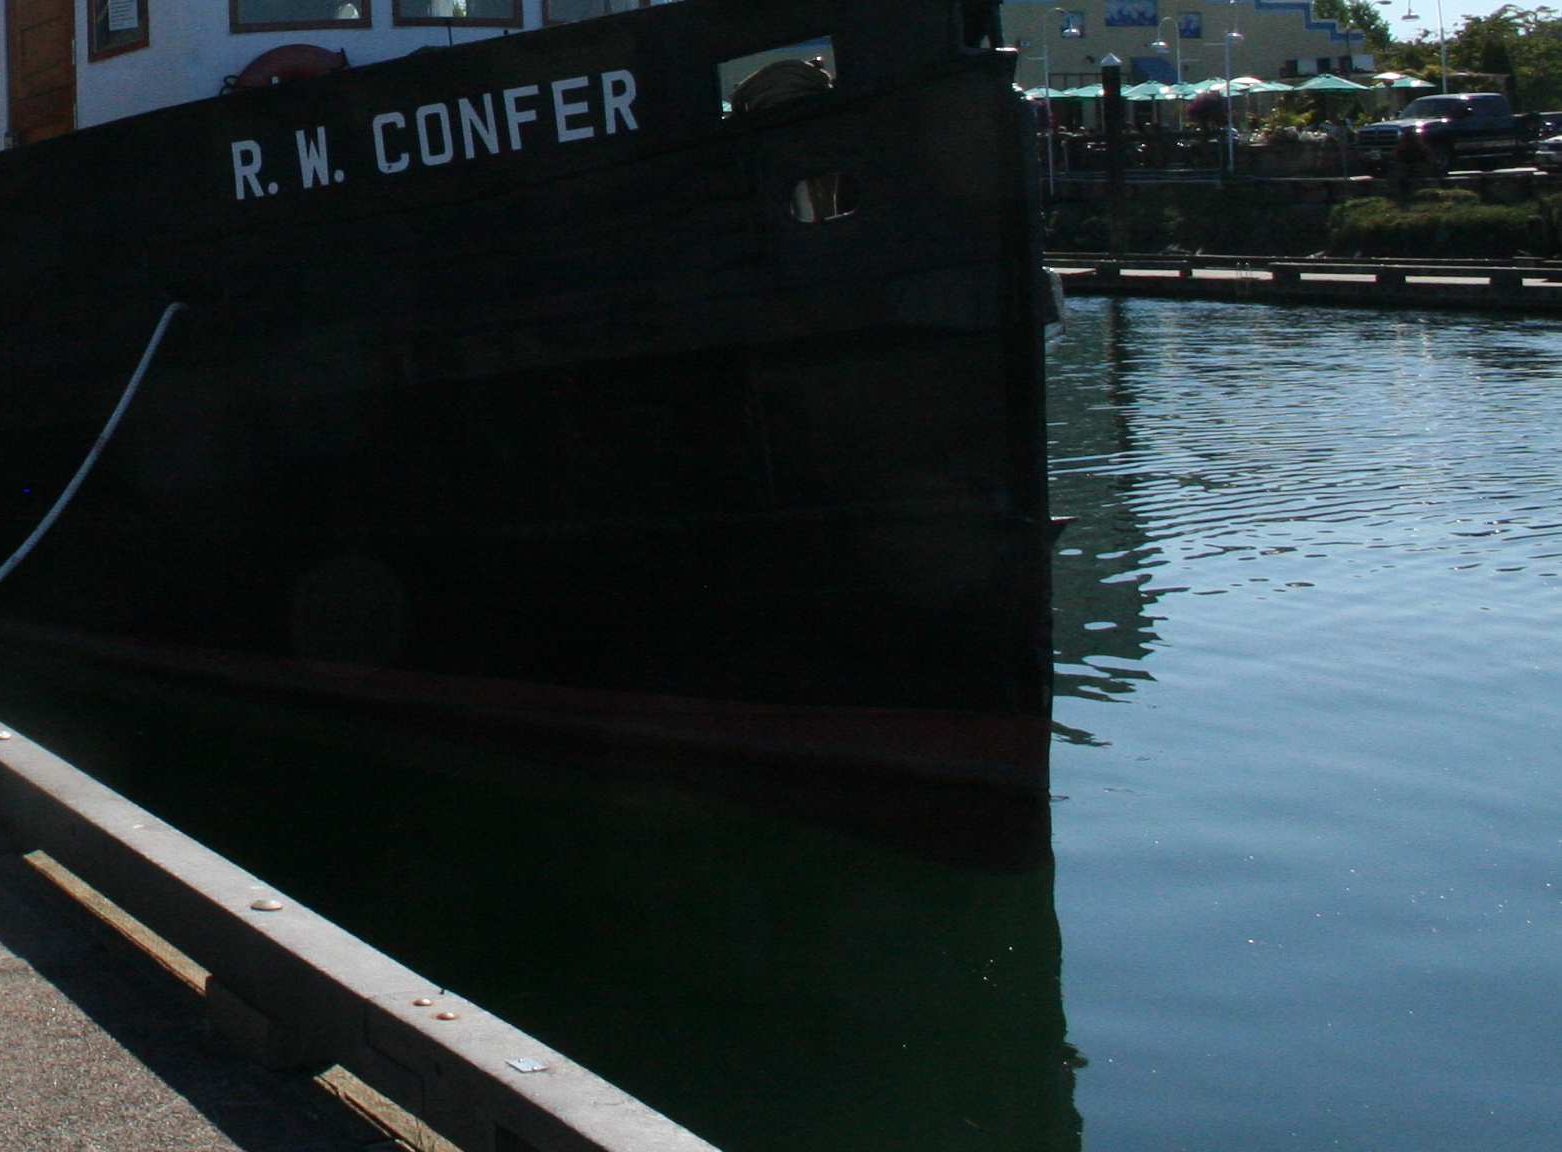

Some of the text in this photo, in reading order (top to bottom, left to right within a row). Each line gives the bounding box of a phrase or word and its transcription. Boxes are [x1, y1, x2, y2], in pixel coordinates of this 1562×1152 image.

[231, 69, 639, 200] R. W. CONFER
